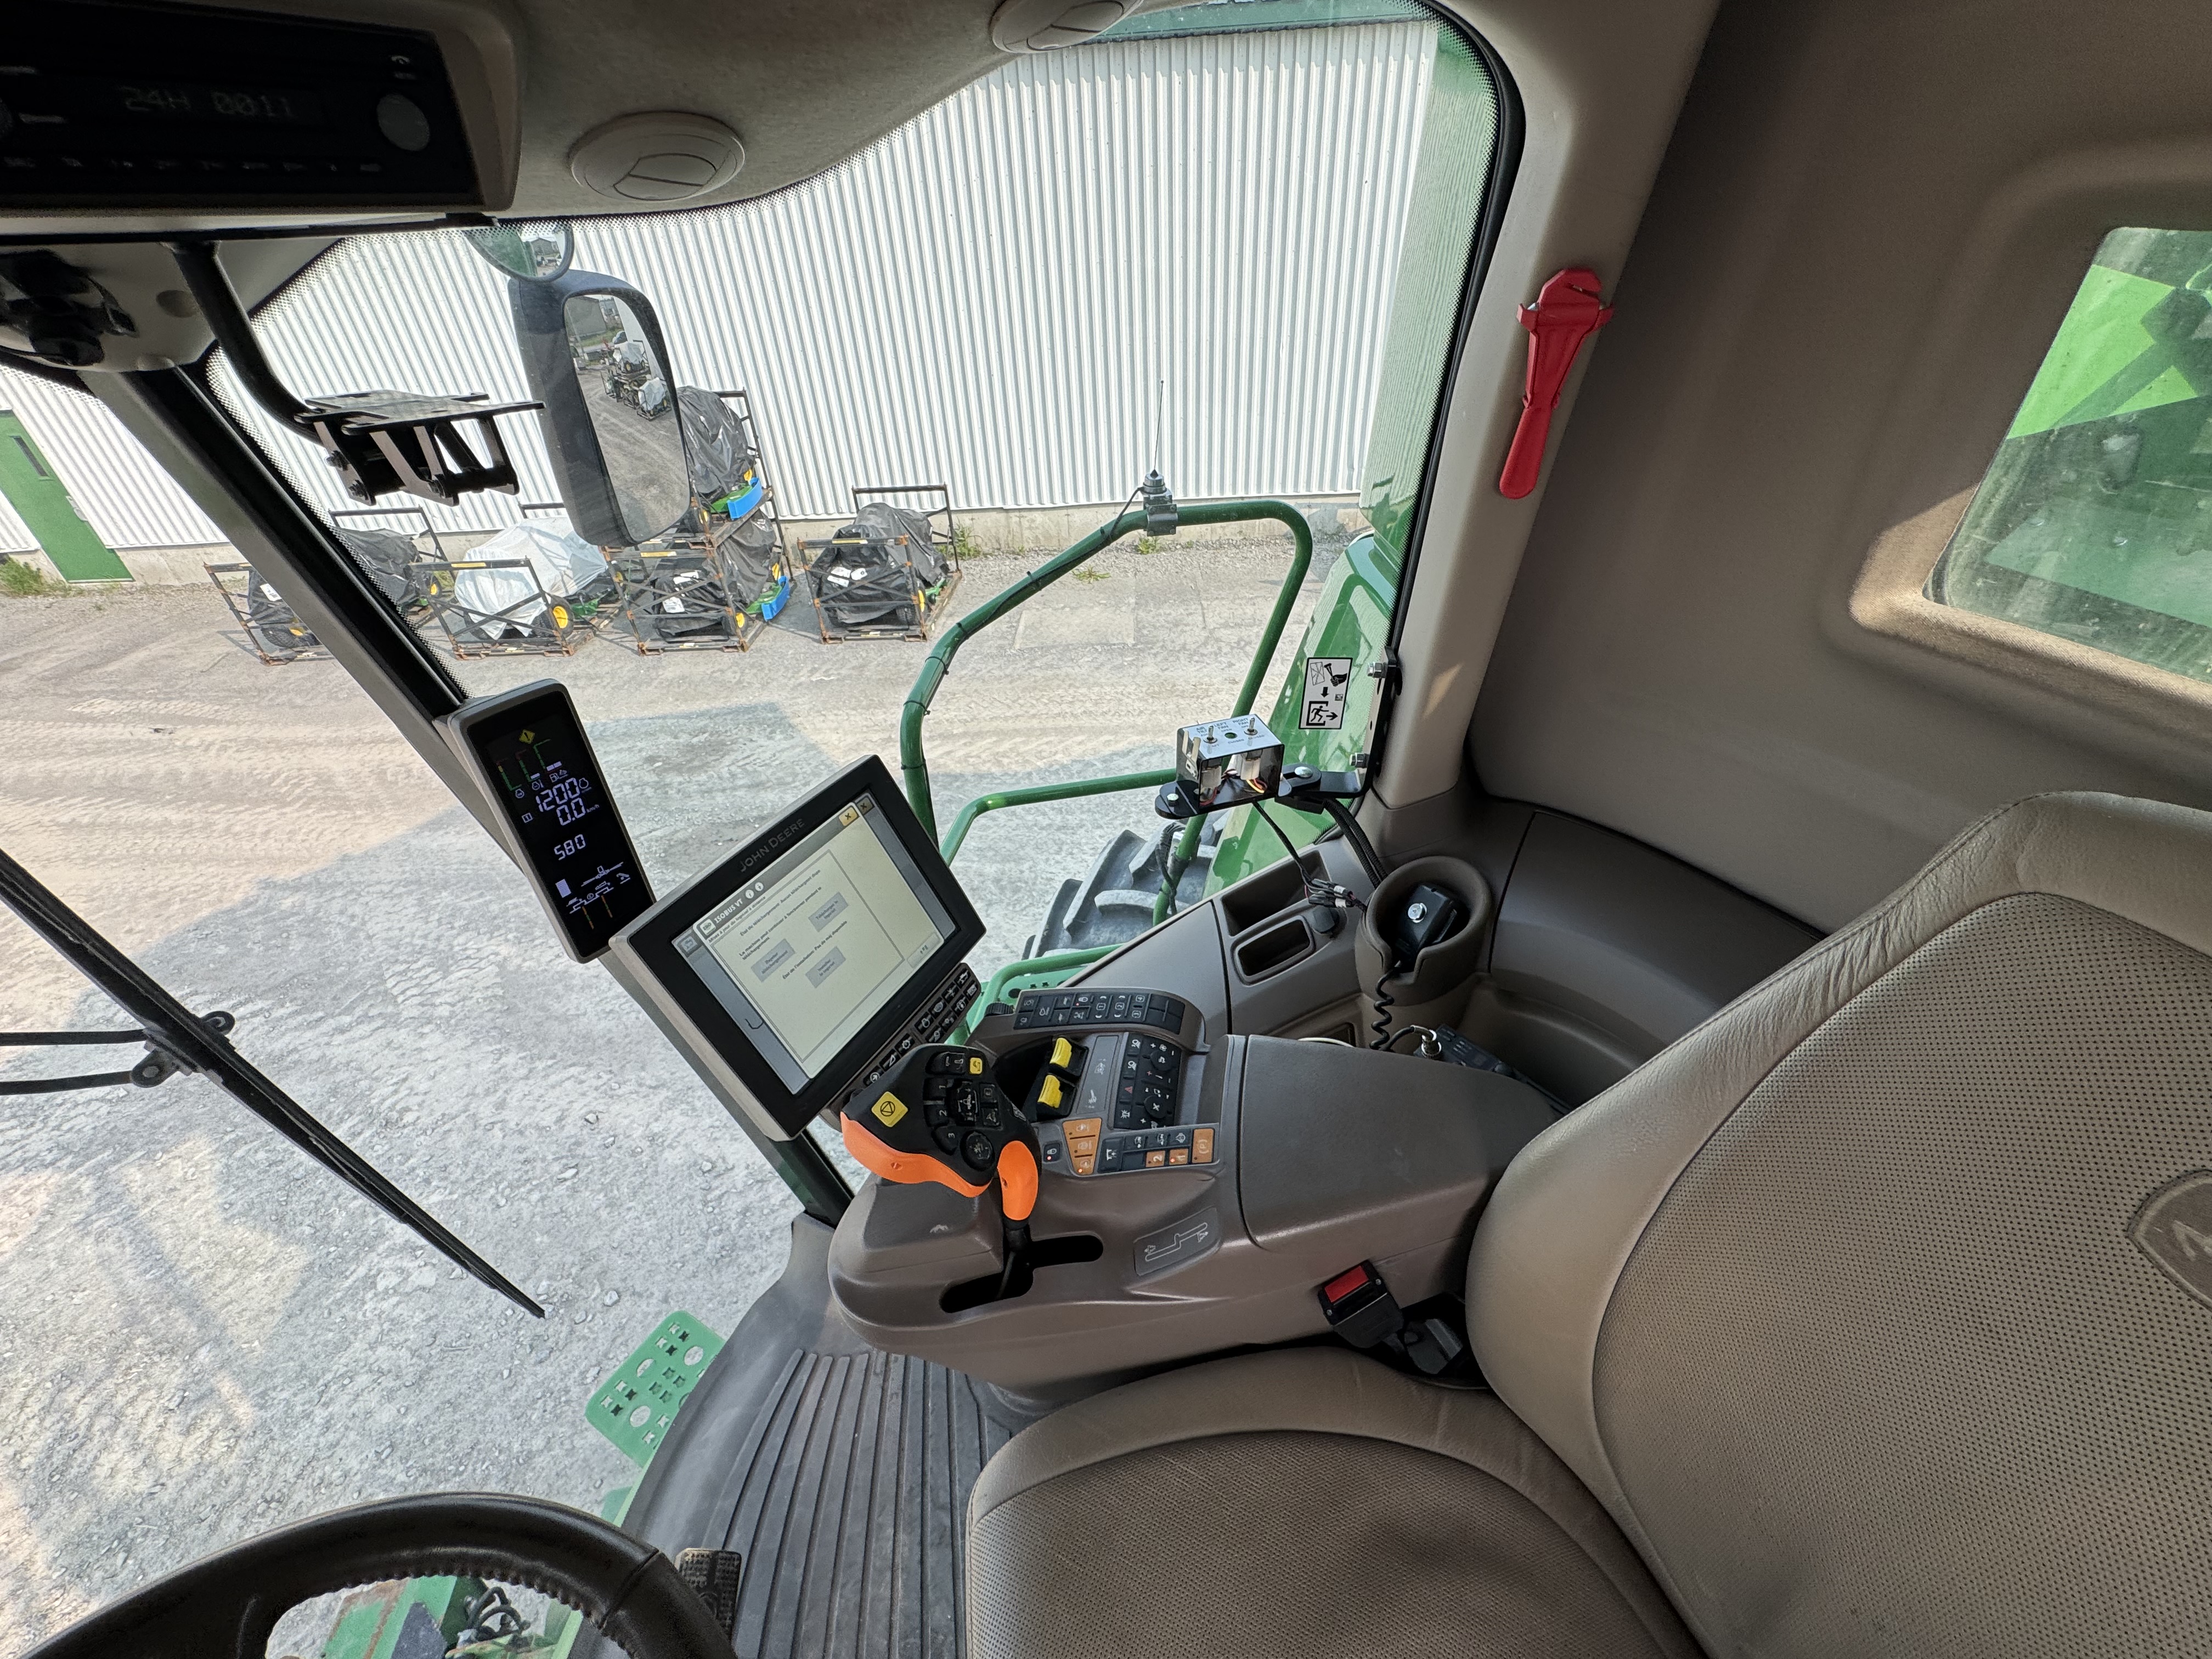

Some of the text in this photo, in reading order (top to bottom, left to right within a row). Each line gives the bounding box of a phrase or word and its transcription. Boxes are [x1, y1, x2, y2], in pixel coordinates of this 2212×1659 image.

[535, 777, 580, 812] 1200
[556, 798, 586, 826] 0.0
[554, 834, 586, 860] 580
[739, 818, 805, 872] JOHN DEERE
[713, 898, 743, 923] ISOBUS VT
[744, 937, 760, 952] machine
[759, 930, 769, 940] peut
[768, 917, 785, 932] continuer
[831, 919, 848, 935] disponible
